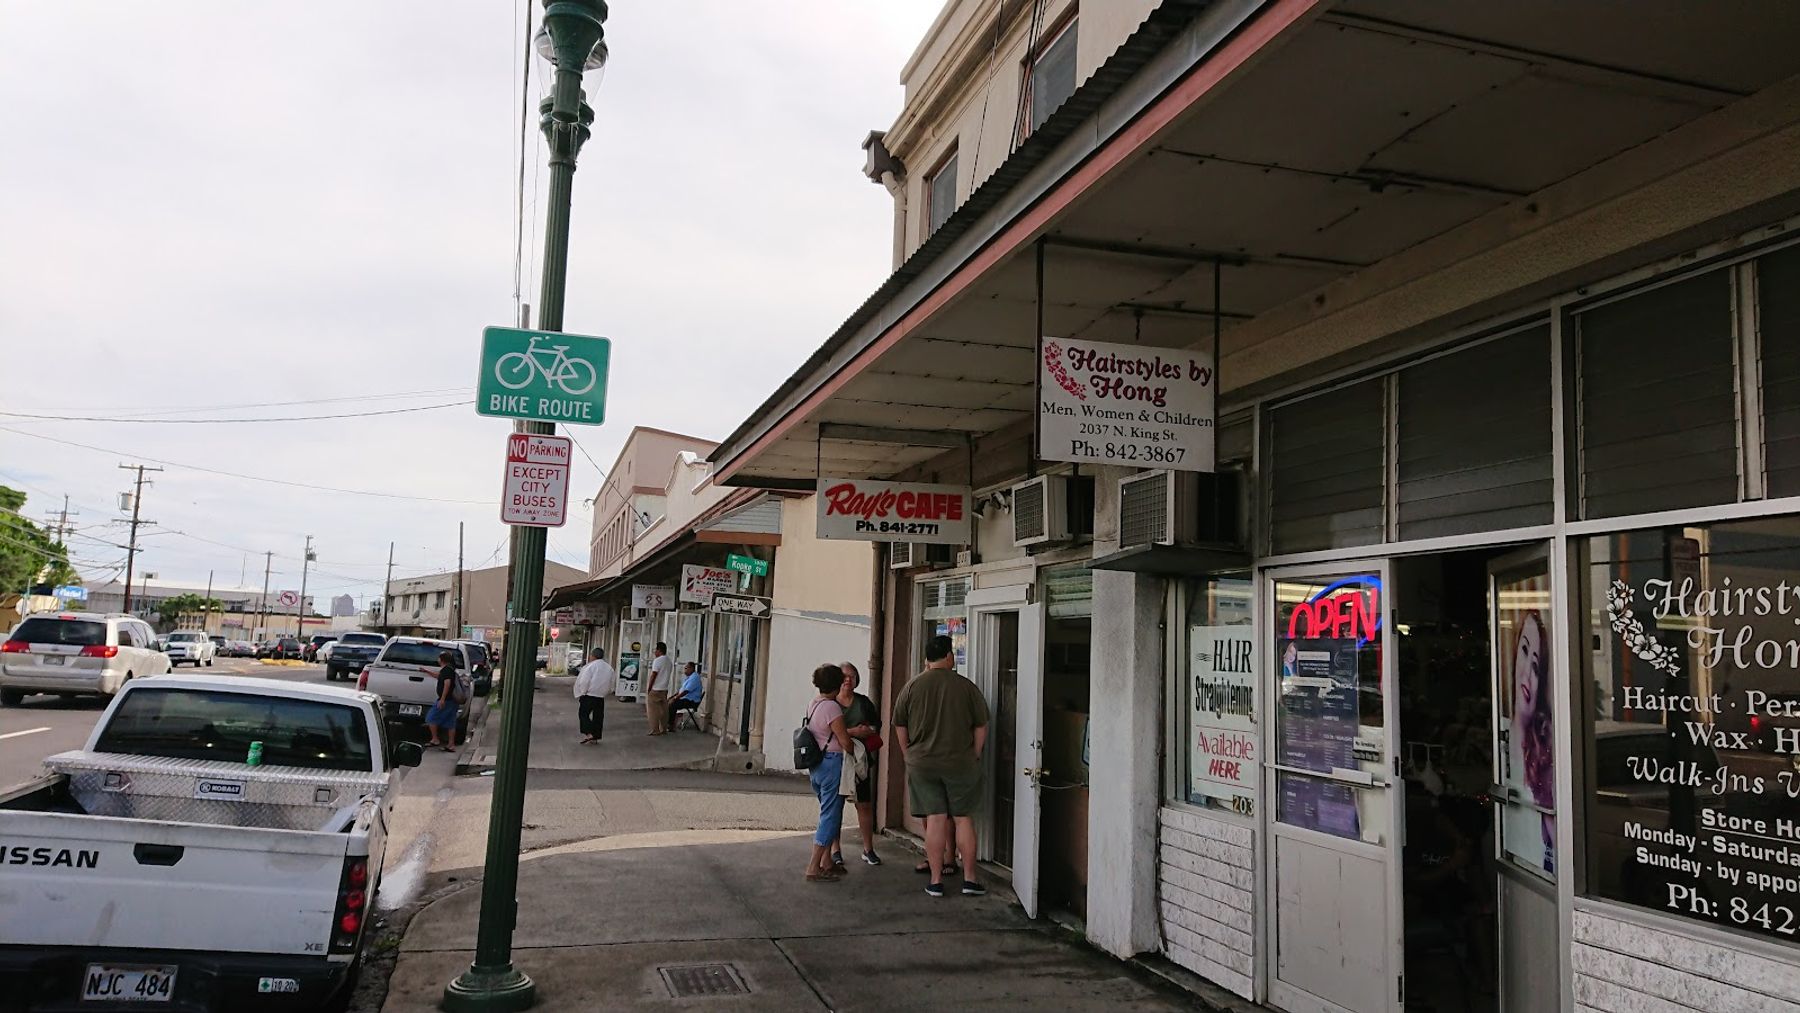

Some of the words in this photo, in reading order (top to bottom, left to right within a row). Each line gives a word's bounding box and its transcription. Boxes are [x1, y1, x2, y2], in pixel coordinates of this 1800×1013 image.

[1067, 346, 1181, 381] Hairstyles
[1188, 360, 1212, 387] by
[1089, 375, 1168, 407] Hong
[490, 394, 529, 413] BIKE
[538, 398, 592, 419] ROUTE
[1042, 401, 1077, 417] Men,
[1080, 404, 1134, 421] Women
[1138, 410, 1150, 422] &
[1154, 411, 1213, 427] Children
[1079, 423, 1109, 435] 2037
[1113, 425, 1127, 437] N.
[1130, 426, 1160, 442] King
[1162, 430, 1178, 441] St.
[509, 439, 527, 458] NO
[529, 444, 567, 458] PARKING
[1071, 440, 1100, 457] Ph:
[1105, 442, 1186, 464] 842-3867
[513, 466, 561, 481] EXCEPT
[521, 481, 550, 493] CITY
[513, 494, 556, 508] BUSES
[824, 482, 897, 520] Ray's
[896, 491, 963, 521] CAFE
[855, 520, 877, 532] Ph.
[879, 521, 939, 535] 841-2771
[718, 598, 734, 608] ONE
[737, 600, 753, 610] WAY
[1288, 587, 1378, 641] OPEN
[1212, 638, 1253, 674] HAIR
[1195, 675, 1255, 723] Straightening
[1622, 686, 1722, 713] Haircut
[1745, 690, 1800, 718] Per
[1197, 731, 1254, 761] Available
[1684, 721, 1749, 750] Wax
[1209, 758, 1241, 780] HERE
[1626, 756, 1765, 795] Walk-Ins
[211, 784, 240, 793] KOBALT
[1701, 808, 1767, 834] Store
[1624, 821, 1696, 853] Monday
[1712, 835, 1800, 867] Saturda
[1636, 846, 1702, 878] Sunday
[1717, 861, 1740, 885] by
[1666, 882, 1718, 917] Ph:
[1730, 896, 1800, 935] 842
[304, 942, 324, 951] XE
[87, 973, 125, 995] NJC
[134, 974, 170, 996] 484
